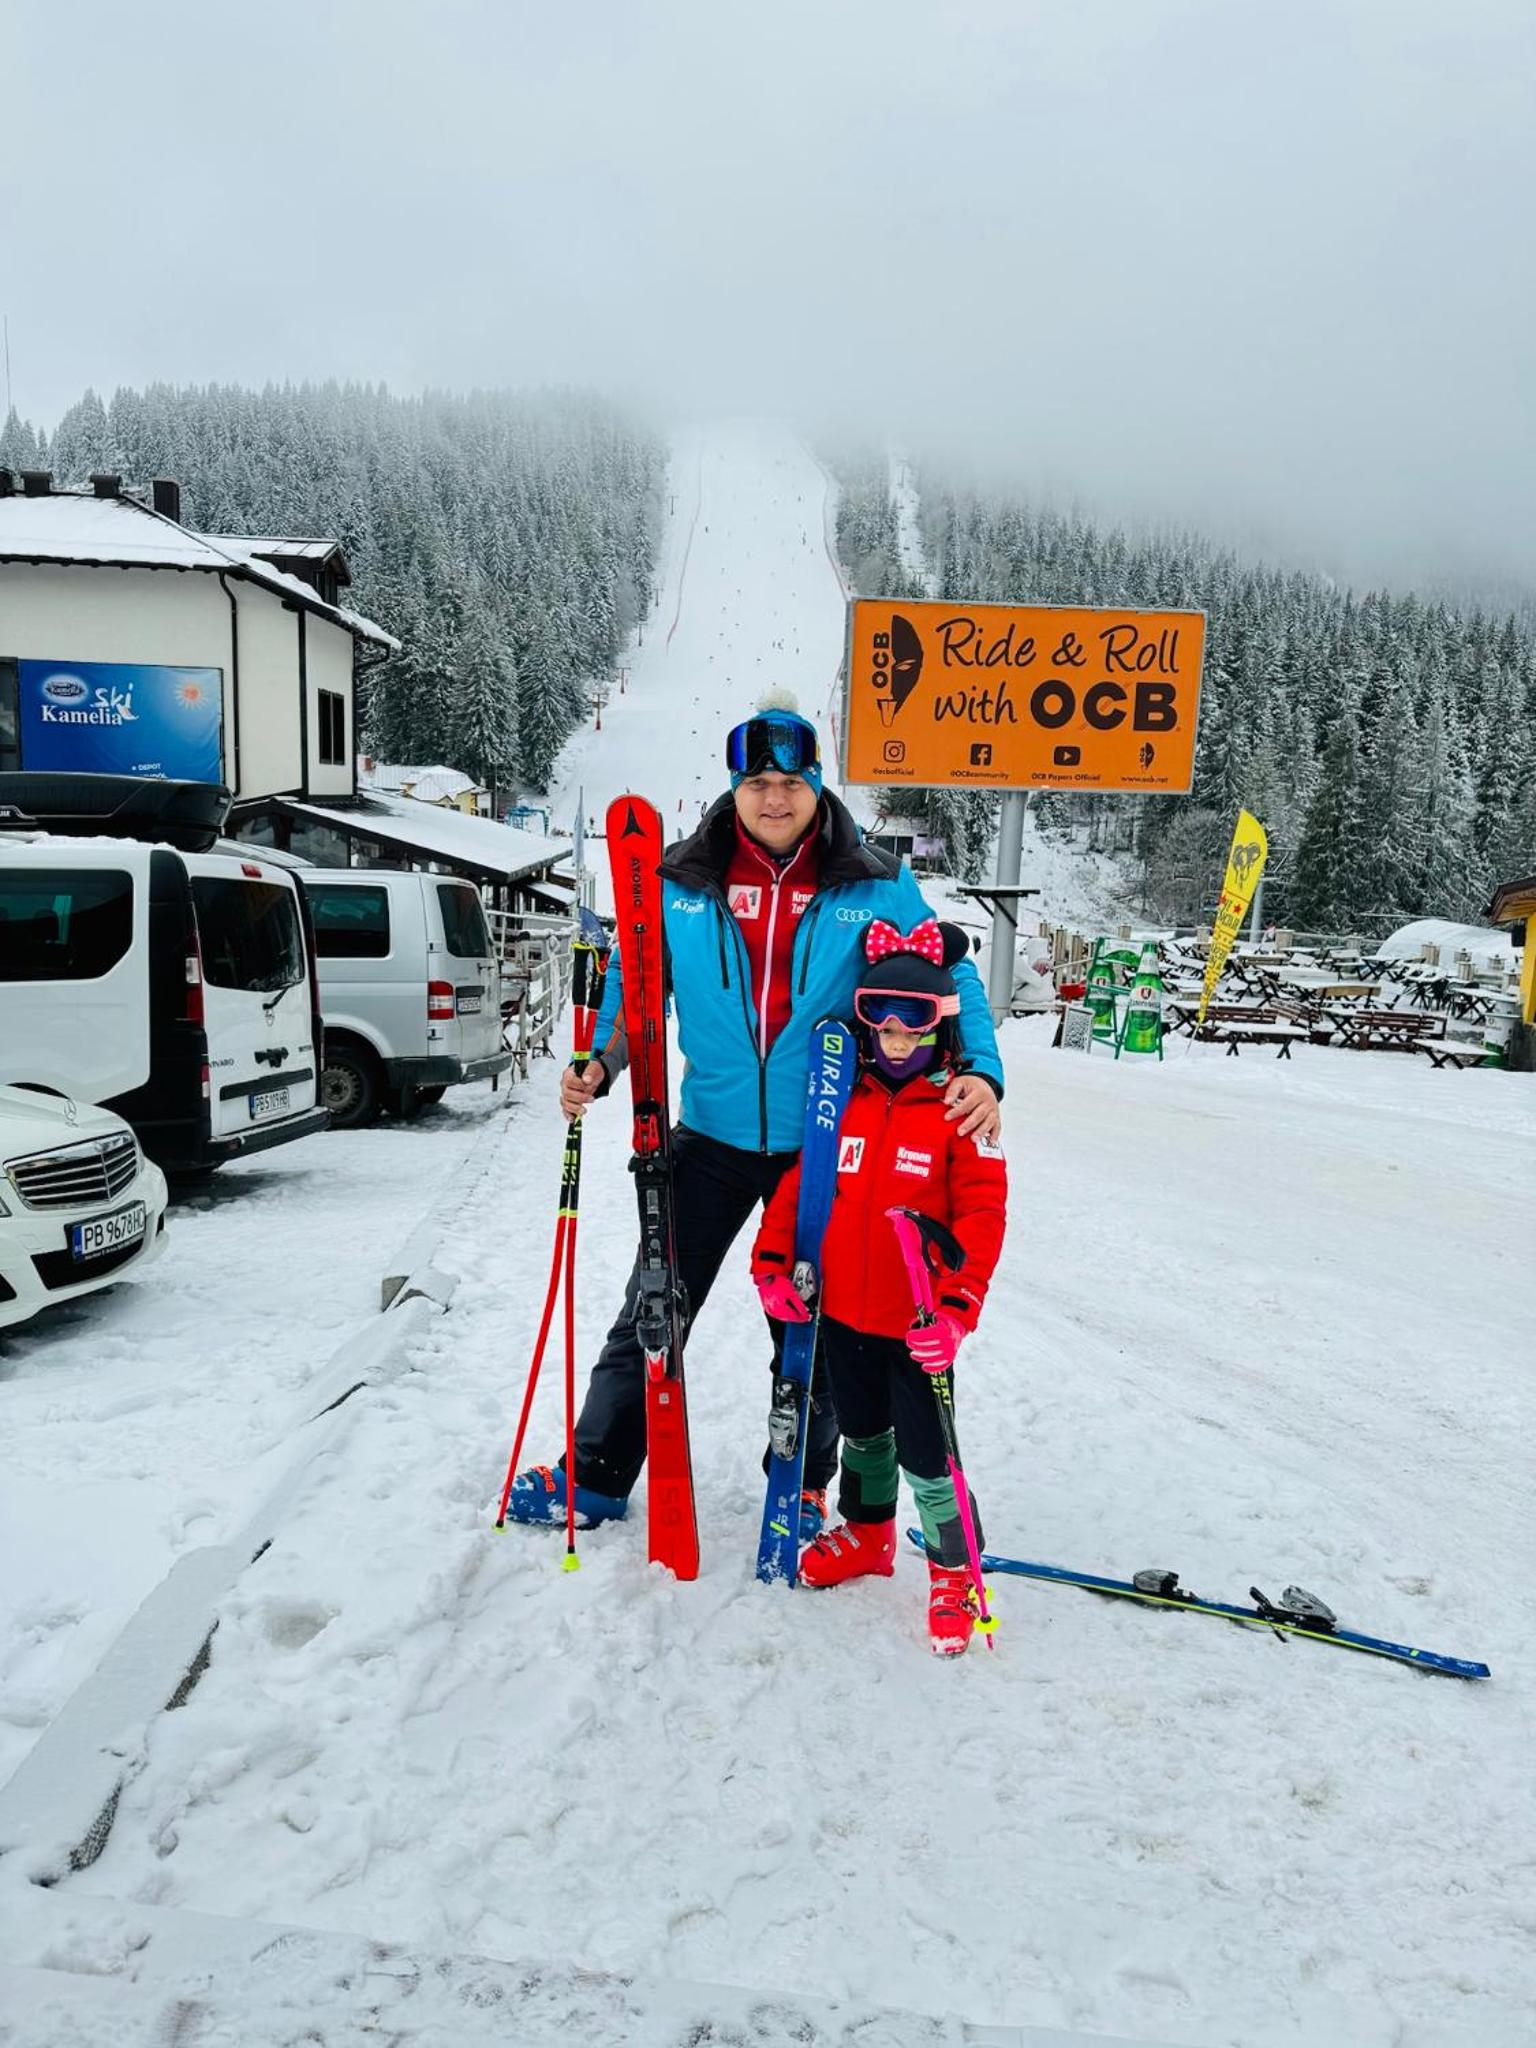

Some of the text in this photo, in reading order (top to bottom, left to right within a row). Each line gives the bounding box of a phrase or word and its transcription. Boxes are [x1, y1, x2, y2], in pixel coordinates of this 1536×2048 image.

[935, 617, 1179, 673] Ride & Roll
[872, 632, 890, 688] OCB
[90, 682, 138, 718] Ski
[935, 679, 1178, 732] with OCB
[41, 705, 122, 725] Kamelia
[1031, 772, 1046, 780] OCB
[630, 857, 643, 908] ATOMIC
[841, 1141, 862, 1168] A1
[897, 1147, 932, 1164] Kronen
[895, 1161, 930, 1178] Zeitung
[84, 1224, 104, 1250] PB
[774, 1513, 789, 1528] JR
